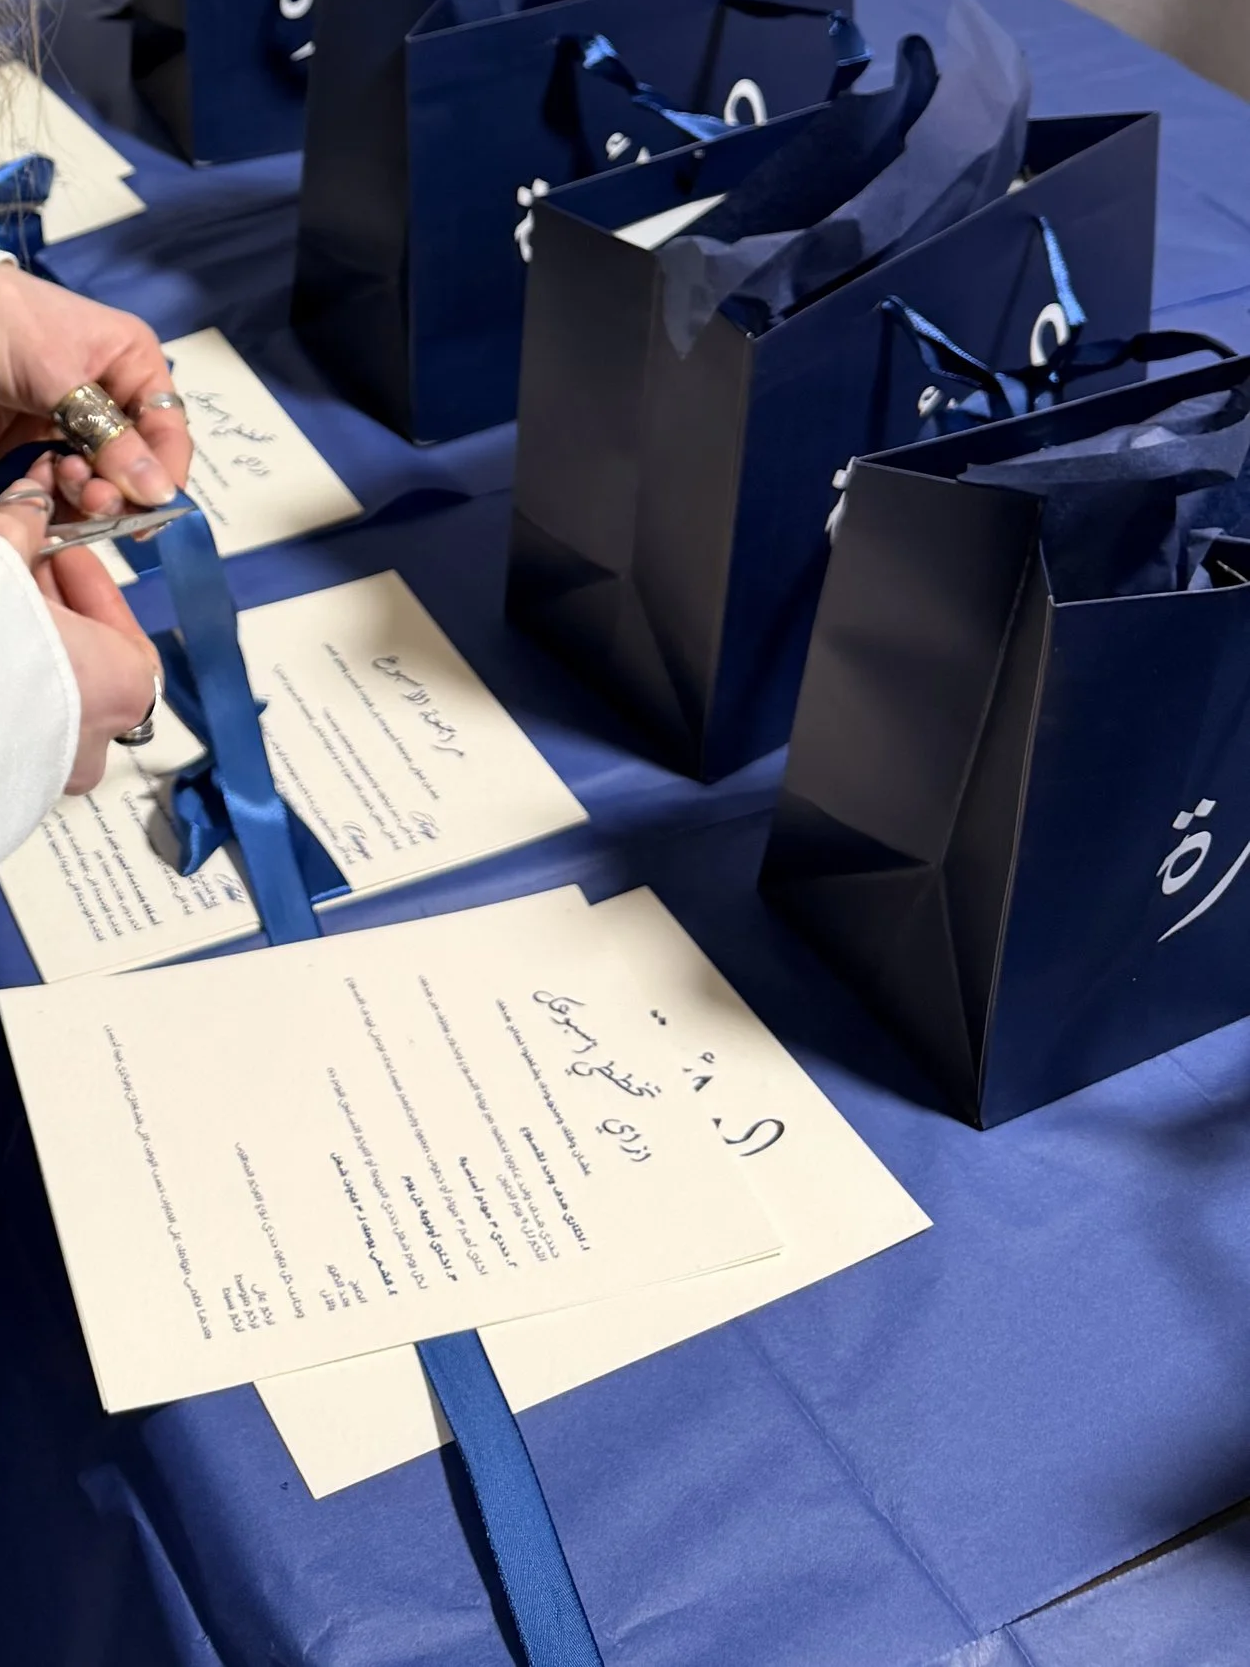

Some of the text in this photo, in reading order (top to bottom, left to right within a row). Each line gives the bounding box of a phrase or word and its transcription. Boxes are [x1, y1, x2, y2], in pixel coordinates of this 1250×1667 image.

[562, 1126, 576, 1149] وقتك
[571, 1151, 591, 1176] عشان
[401, 1176, 416, 1192] يوم
[541, 1165, 555, 1185] واحد
[518, 1182, 532, 1201] واحد
[553, 1186, 568, 1210] هدف
[380, 1201, 399, 1226] حددي
[442, 1196, 459, 1217] مهام
[474, 1196, 491, 1219] مهام
[508, 1202, 523, 1217] يوم
[528, 1202, 545, 1228] هدف
[261, 1222, 278, 1248] حددي
[361, 1223, 376, 1249] يومك
[456, 1228, 478, 1247] أهم
[490, 1231, 510, 1257] حددي
[538, 1230, 560, 1258] حددي
[402, 1253, 417, 1268] يوم
[279, 1270, 293, 1285] كل
[410, 1270, 429, 1289] لكل
[338, 1290, 350, 1308] بعد
